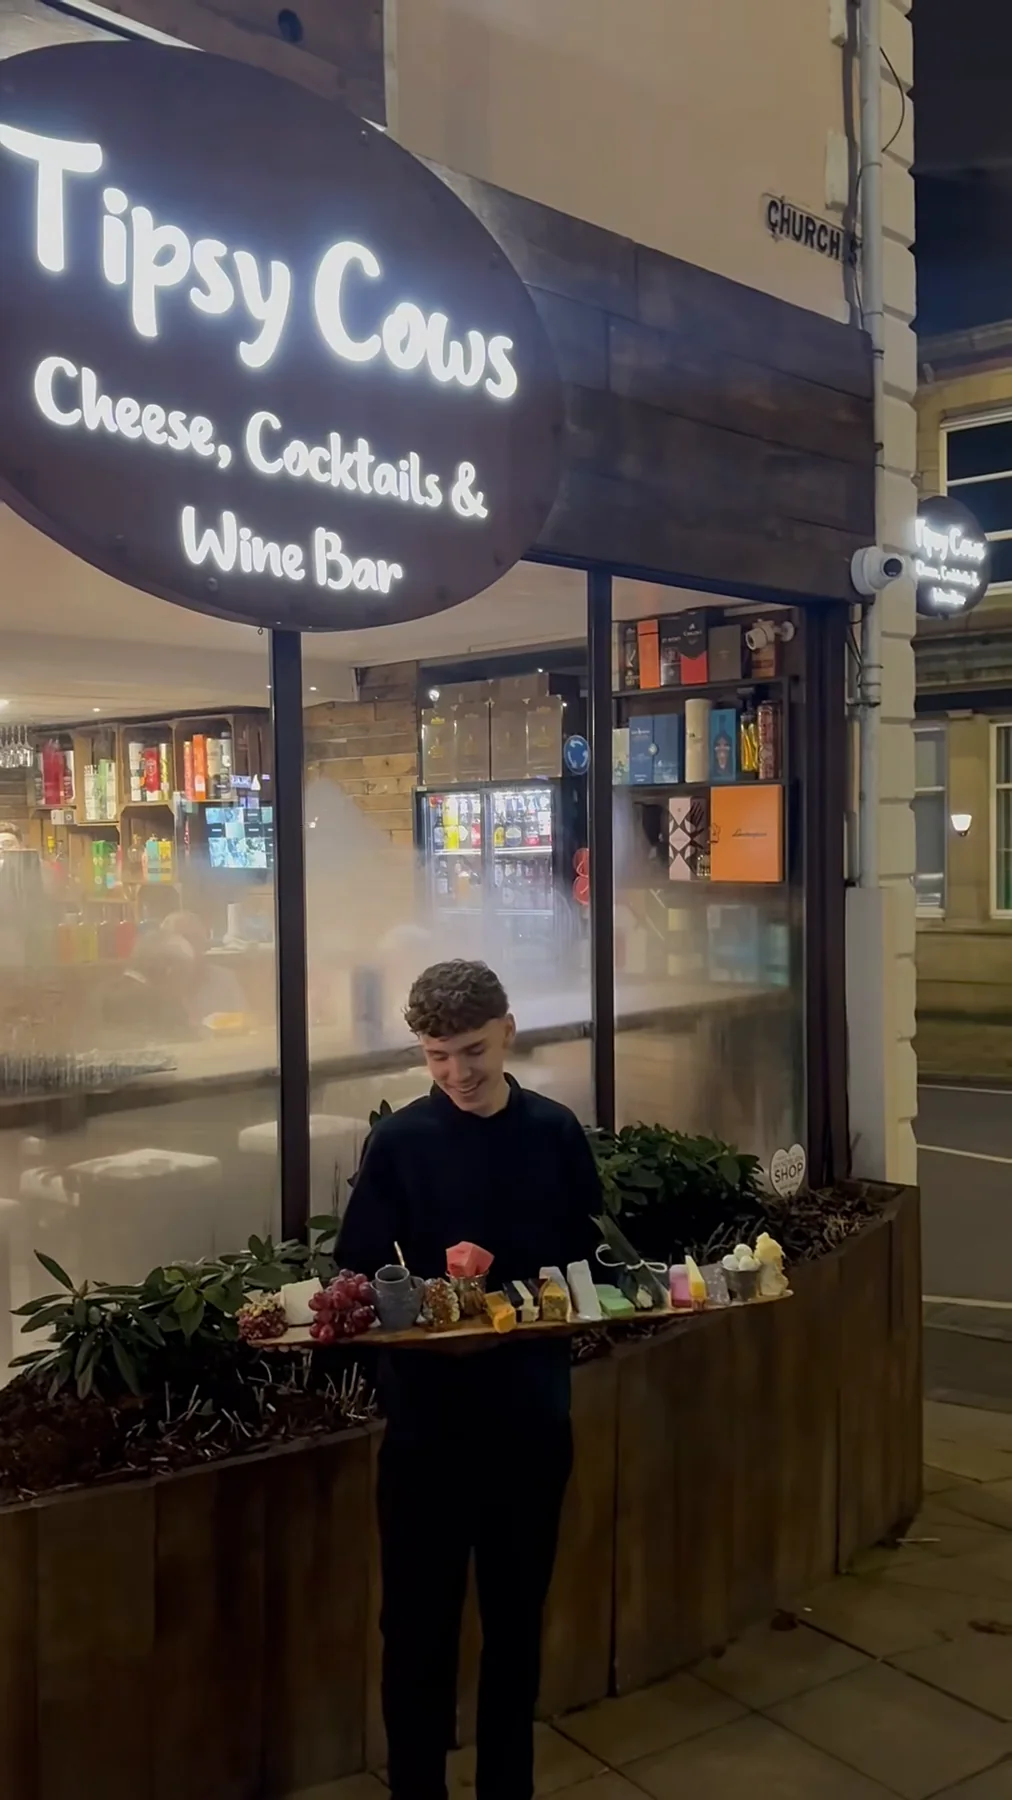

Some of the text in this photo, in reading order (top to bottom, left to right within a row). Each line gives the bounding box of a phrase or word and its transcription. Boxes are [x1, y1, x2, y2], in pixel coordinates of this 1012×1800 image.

[0, 122, 519, 400] Tipsy Cows
[767, 199, 841, 260] CHURCH
[34, 355, 489, 520] Cheese, Cocktails &
[181, 504, 405, 594] Wine Bar
[774, 1162, 804, 1183] SHOP
